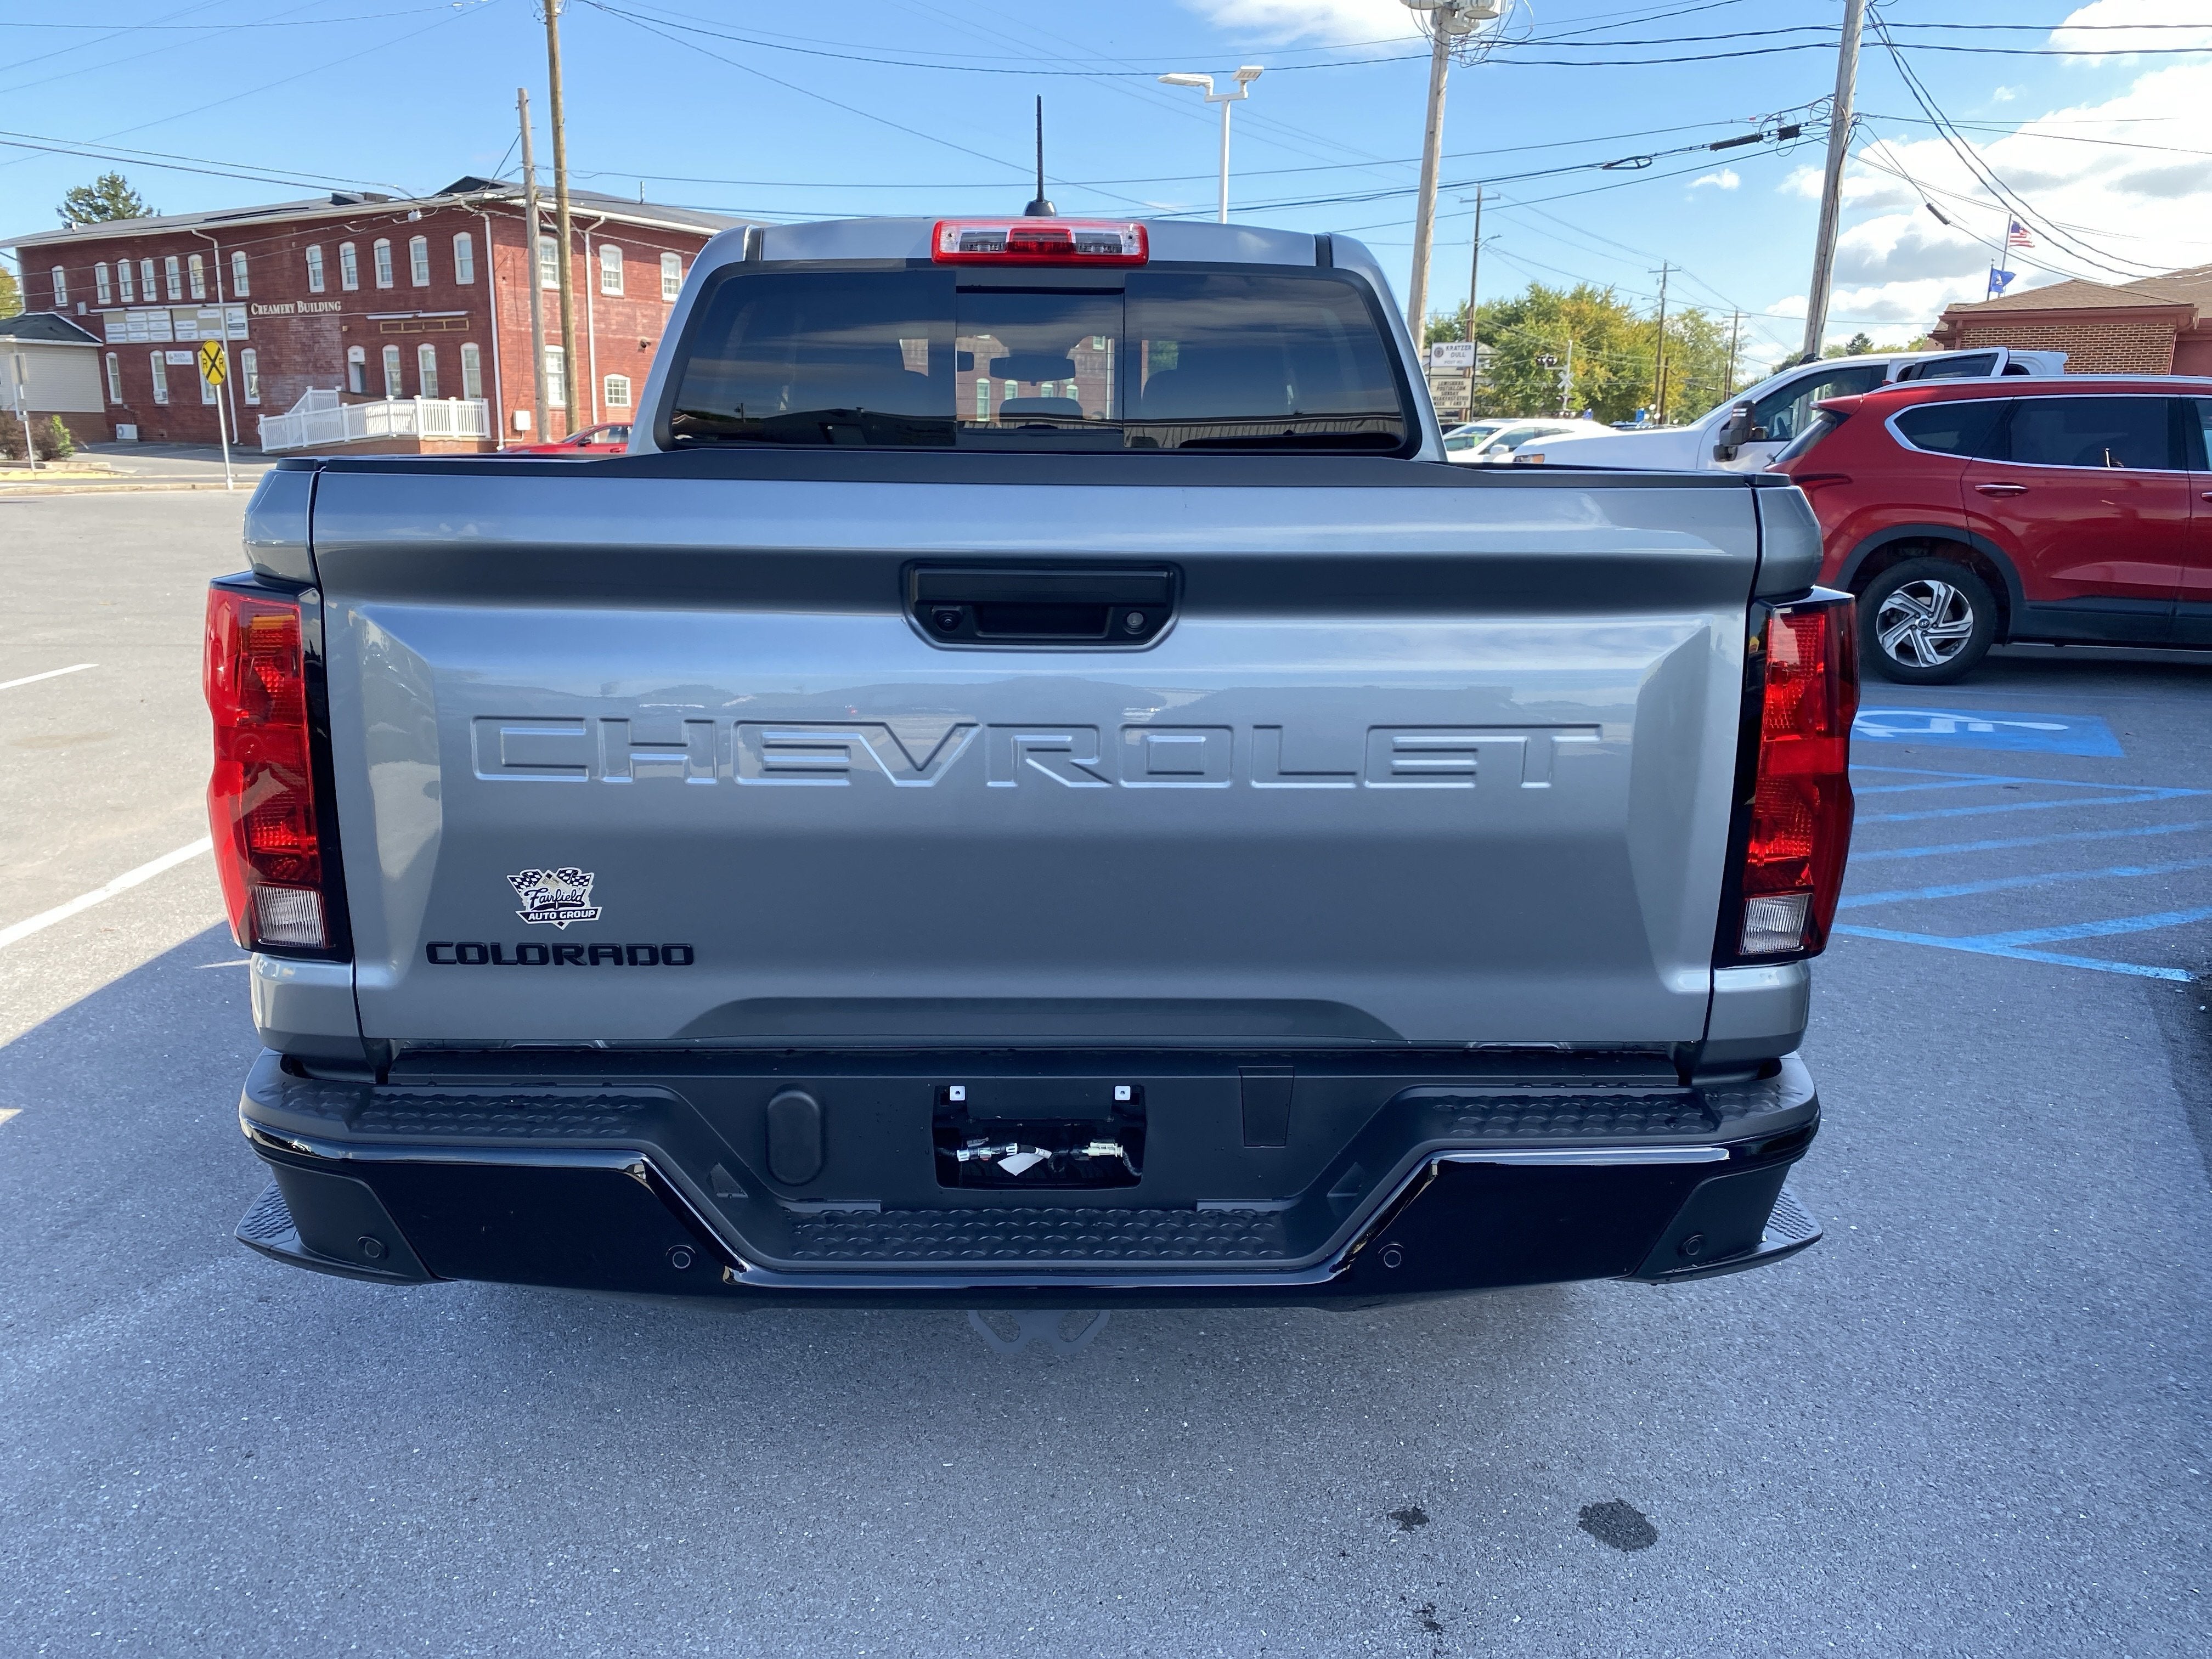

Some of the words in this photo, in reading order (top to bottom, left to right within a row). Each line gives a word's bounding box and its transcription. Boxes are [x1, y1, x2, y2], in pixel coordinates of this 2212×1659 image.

[202, 358, 208, 369] R
[219, 358, 225, 369] R
[470, 715, 1603, 791] CHEVROLET
[523, 887, 586, 909] Fairfield
[528, 912, 557, 921] AUTO
[559, 910, 596, 919] GROUP
[426, 941, 695, 966] COLORADO
